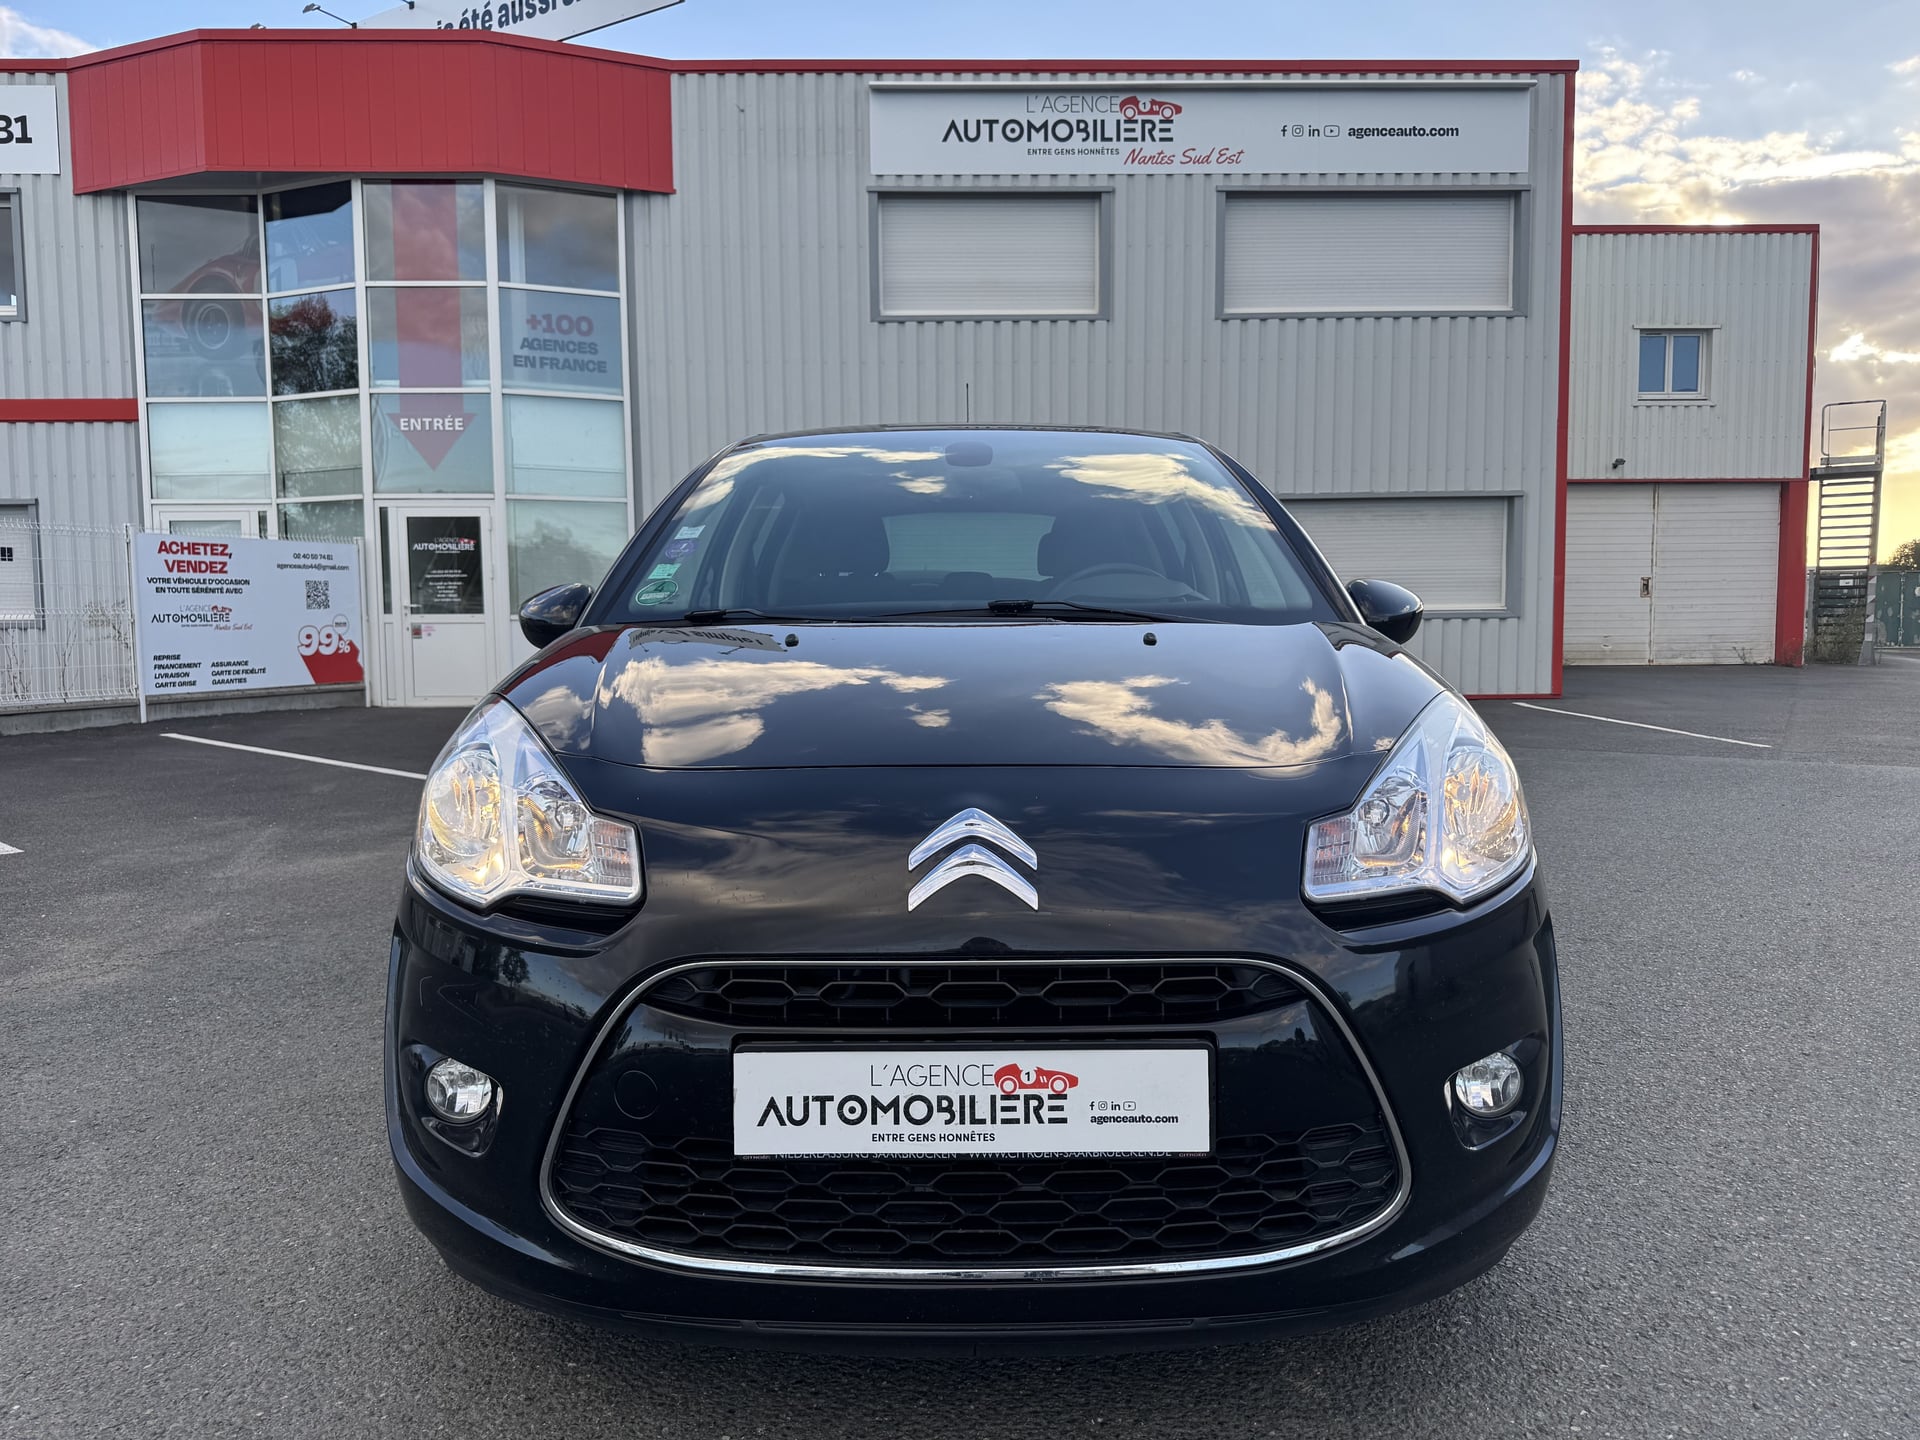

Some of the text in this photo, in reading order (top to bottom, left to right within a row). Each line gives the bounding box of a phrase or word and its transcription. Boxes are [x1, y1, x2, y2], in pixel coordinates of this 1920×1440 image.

[1026, 95, 1119, 113] L'AGENCE
[1348, 126, 1459, 139] agenceauto.com
[1027, 146, 1120, 156] ENTRE GENS HONNÊTES
[1123, 147, 1245, 166] Nantes Sud Est
[526, 314, 594, 337] +100
[520, 337, 599, 355] AGENCES
[513, 355, 608, 373] EN FRANCE
[400, 415, 464, 431] ENTRÉE
[157, 540, 233, 559] ACHETEZ,
[164, 559, 228, 574] VENDEZ
[147, 576, 250, 586] VOTRE VÉHICULE D'OCCASION
[191, 586, 224, 595] SÉRÉNITÉ
[225, 587, 243, 595] AVEC
[154, 662, 202, 670] FINANCEMENT
[211, 660, 249, 668] ASSURANCE
[154, 672, 190, 680] LIVRAISON
[211, 669, 231, 677] CARTE
[241, 667, 267, 675] FIDÉLITÉ
[155, 680, 197, 689] CARTE GRISE
[870, 1064, 994, 1087] L'AGENCE
[1090, 1114, 1179, 1125] agenceauto.com
[871, 1130, 995, 1142] ENTRE GENS HONNÊTES
